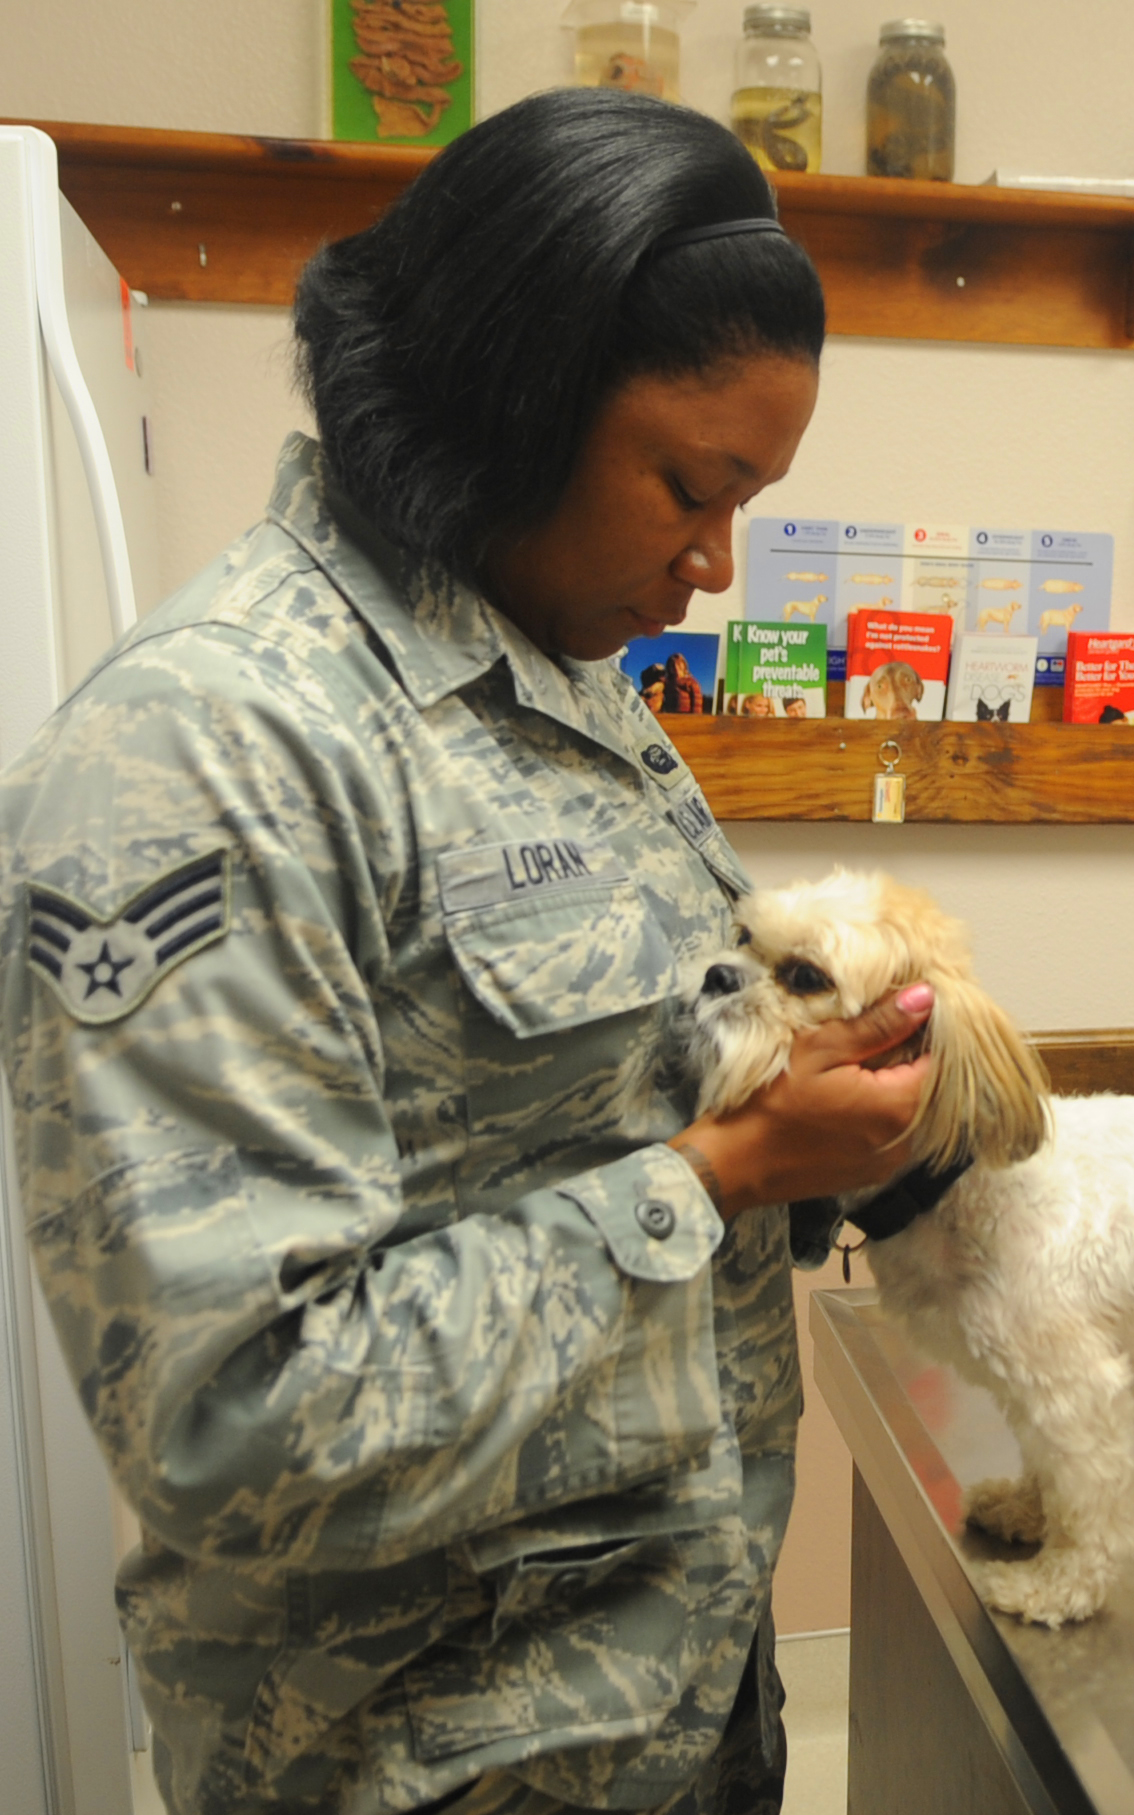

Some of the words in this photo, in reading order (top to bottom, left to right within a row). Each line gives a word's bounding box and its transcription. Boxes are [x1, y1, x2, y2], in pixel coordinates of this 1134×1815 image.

[867, 621, 887, 631] What
[888, 623, 898, 631] do
[899, 625, 913, 633] you
[915, 626, 935, 634] mean
[747, 624, 780, 644] Know
[781, 630, 809, 647] your
[893, 634, 931, 643] protected
[865, 641, 893, 650] against
[893, 643, 941, 653] rattlesnakes?
[760, 645, 788, 665] pet's
[753, 663, 820, 683] preventable
[965, 661, 1029, 672] HEARTWORM
[1076, 661, 1103, 671] Better
[1104, 660, 1118, 671] for
[1075, 671, 1102, 681] Better
[1103, 671, 1117, 681] for
[763, 680, 804, 699] threats
[970, 684, 1026, 702] DOGS
[502, 842, 592, 891] LORAN
